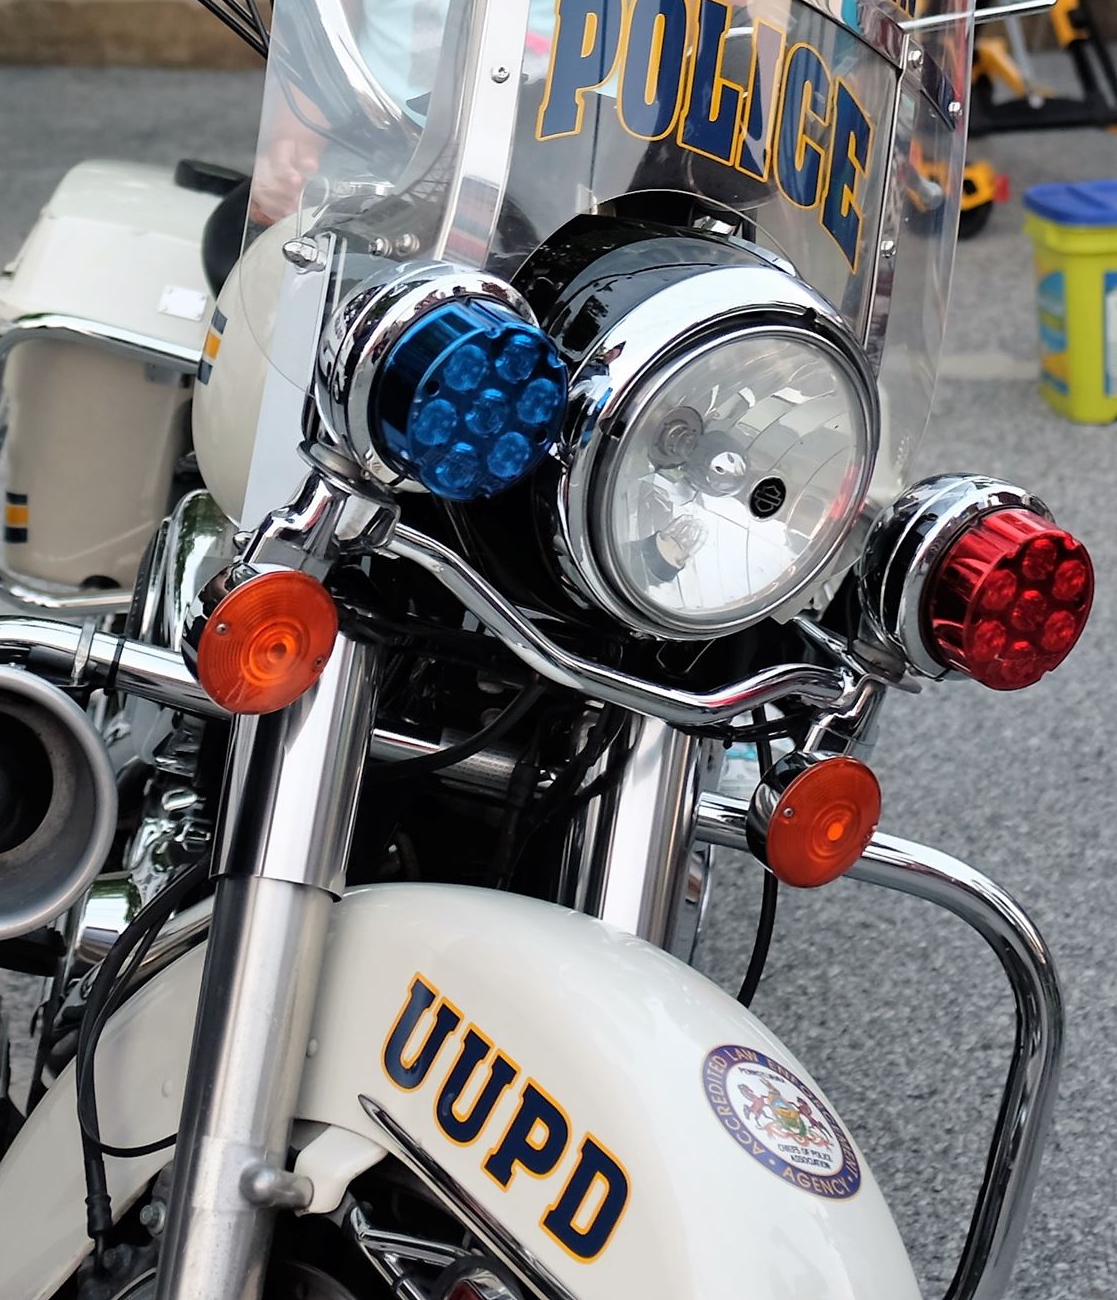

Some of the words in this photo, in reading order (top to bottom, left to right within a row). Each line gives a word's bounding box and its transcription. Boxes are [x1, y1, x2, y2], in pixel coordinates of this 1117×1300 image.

[724, 1048, 759, 1063] LAW
[383, 971, 632, 1264] UUPD
[706, 1055, 766, 1156] ACCREDITED
[782, 1166, 853, 1196] AGENCY
